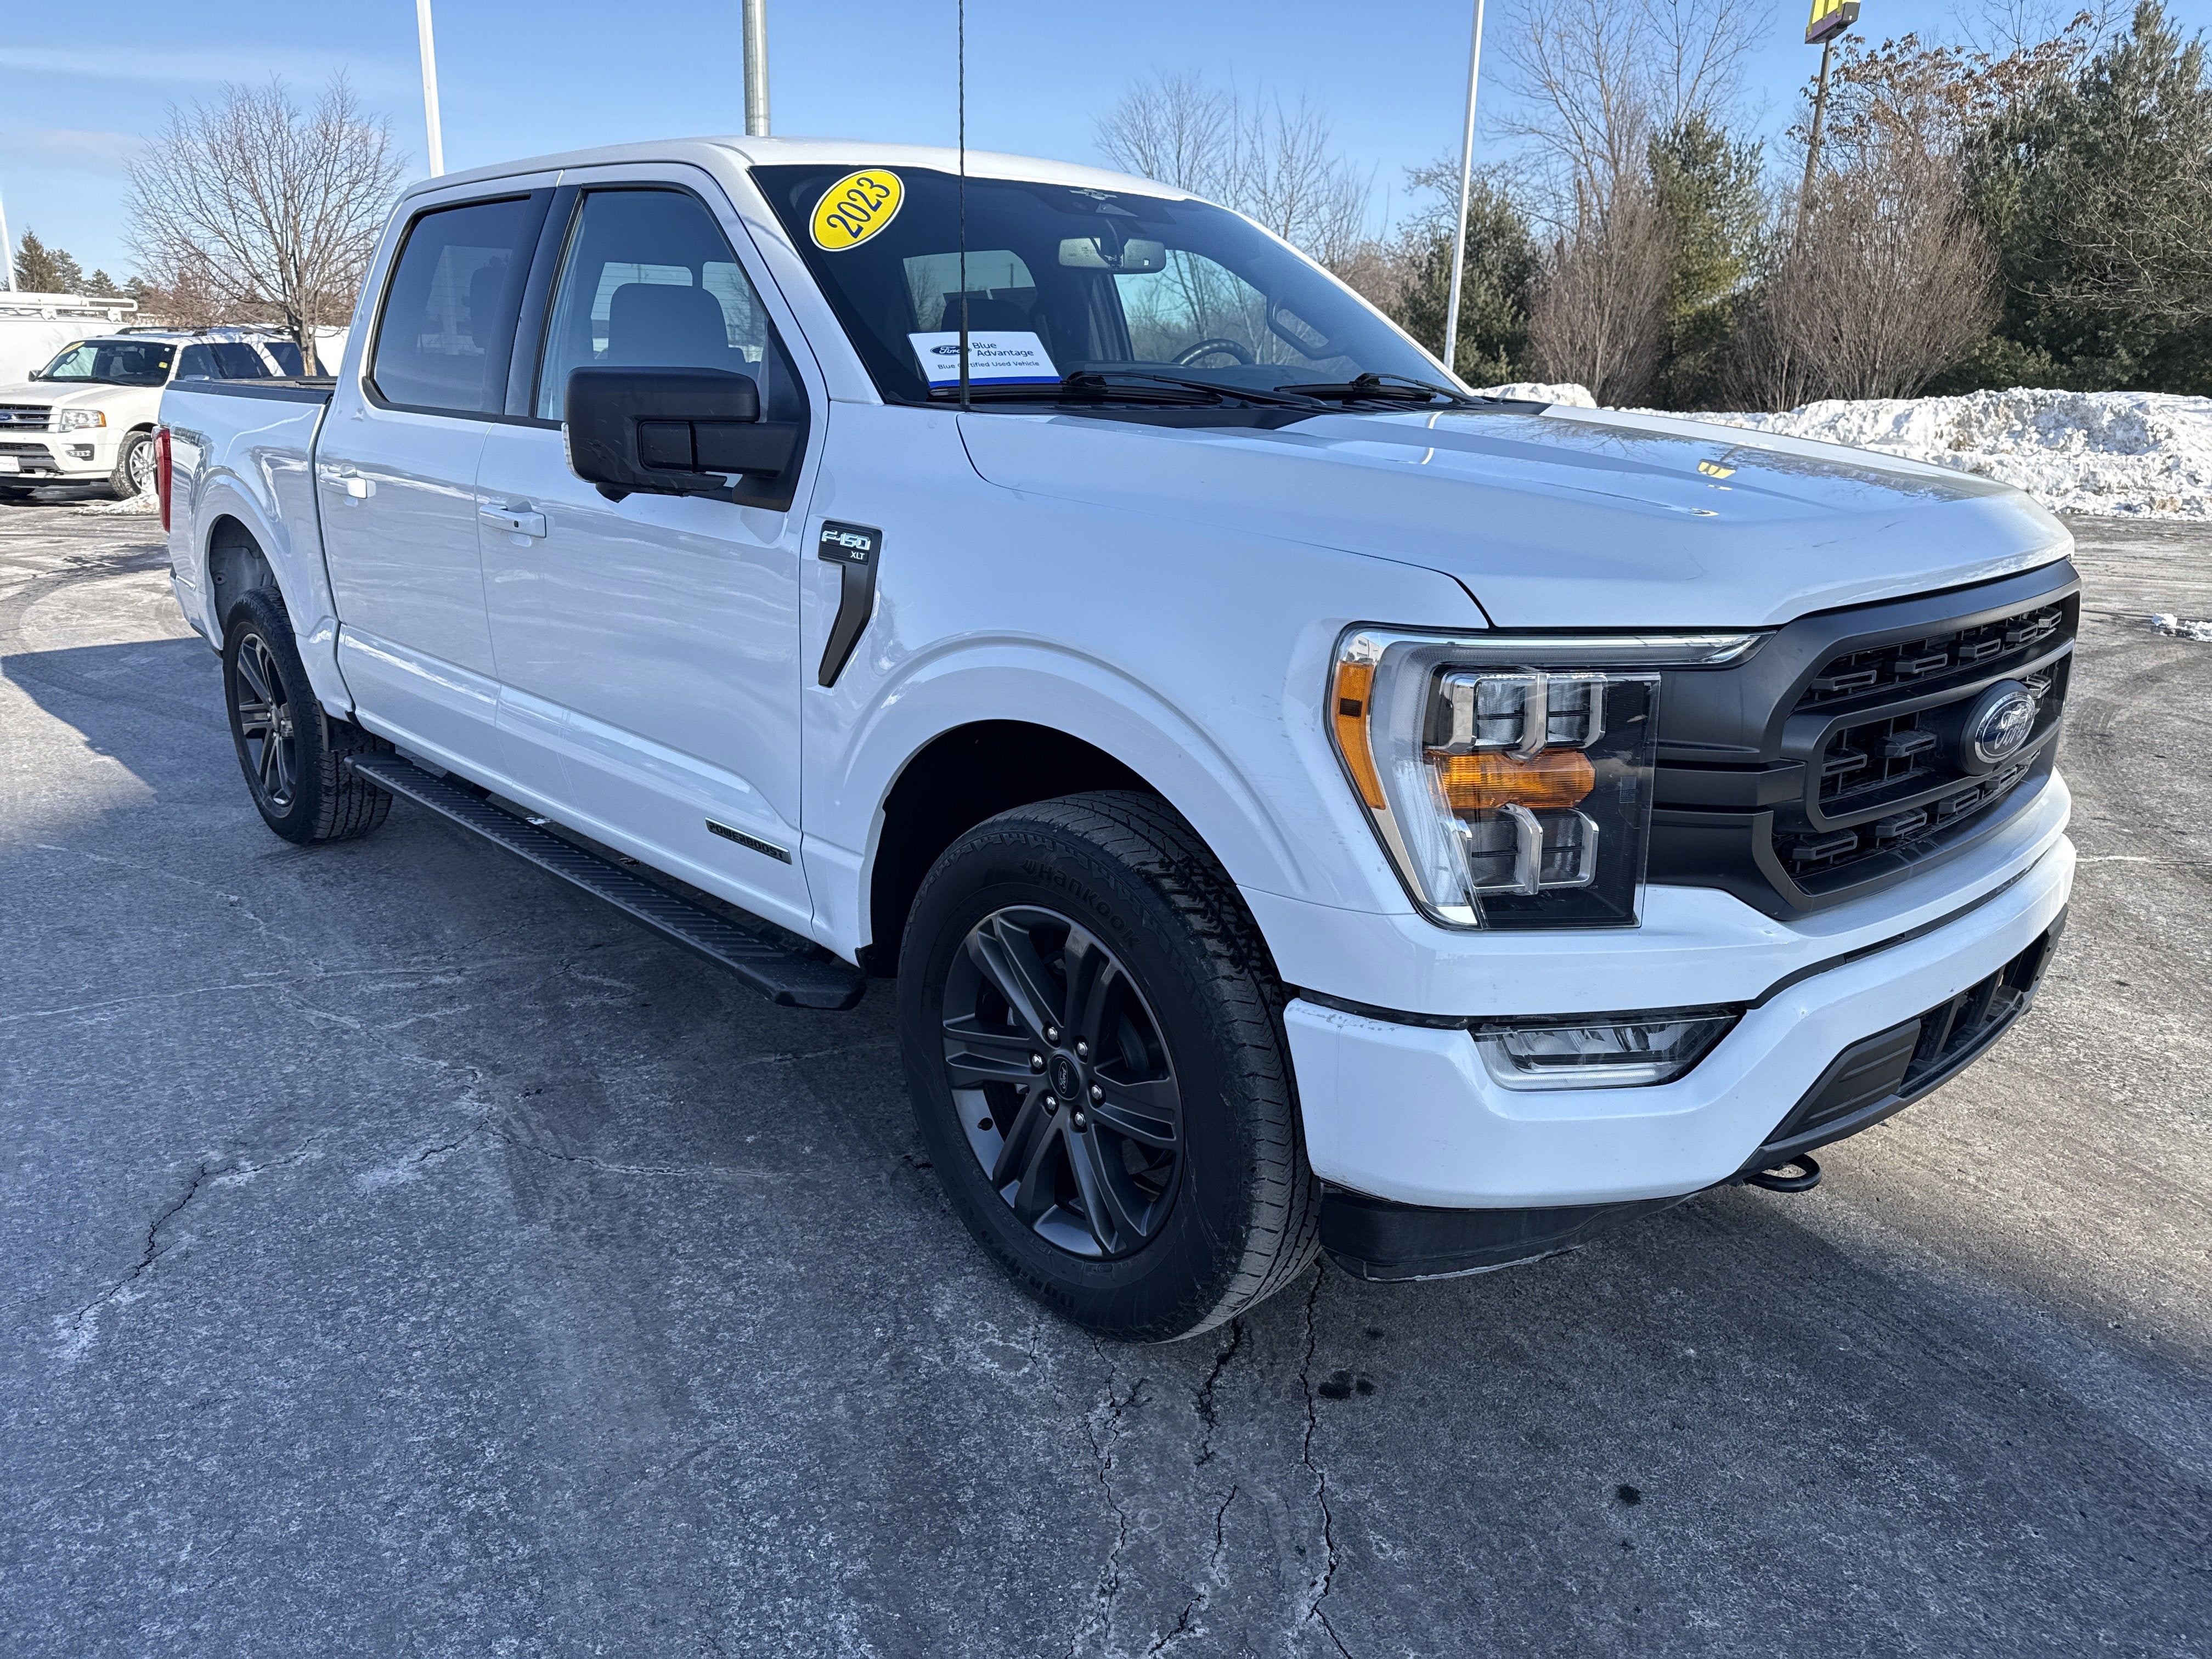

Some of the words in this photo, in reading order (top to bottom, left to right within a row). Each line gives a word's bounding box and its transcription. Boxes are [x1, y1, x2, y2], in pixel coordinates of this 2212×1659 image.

[827, 177, 890, 239] 2023
[821, 530, 871, 550] F-150
[850, 551, 865, 560] XLT
[1994, 707, 2029, 749] Ford
[708, 821, 783, 859] POWERBOOST
